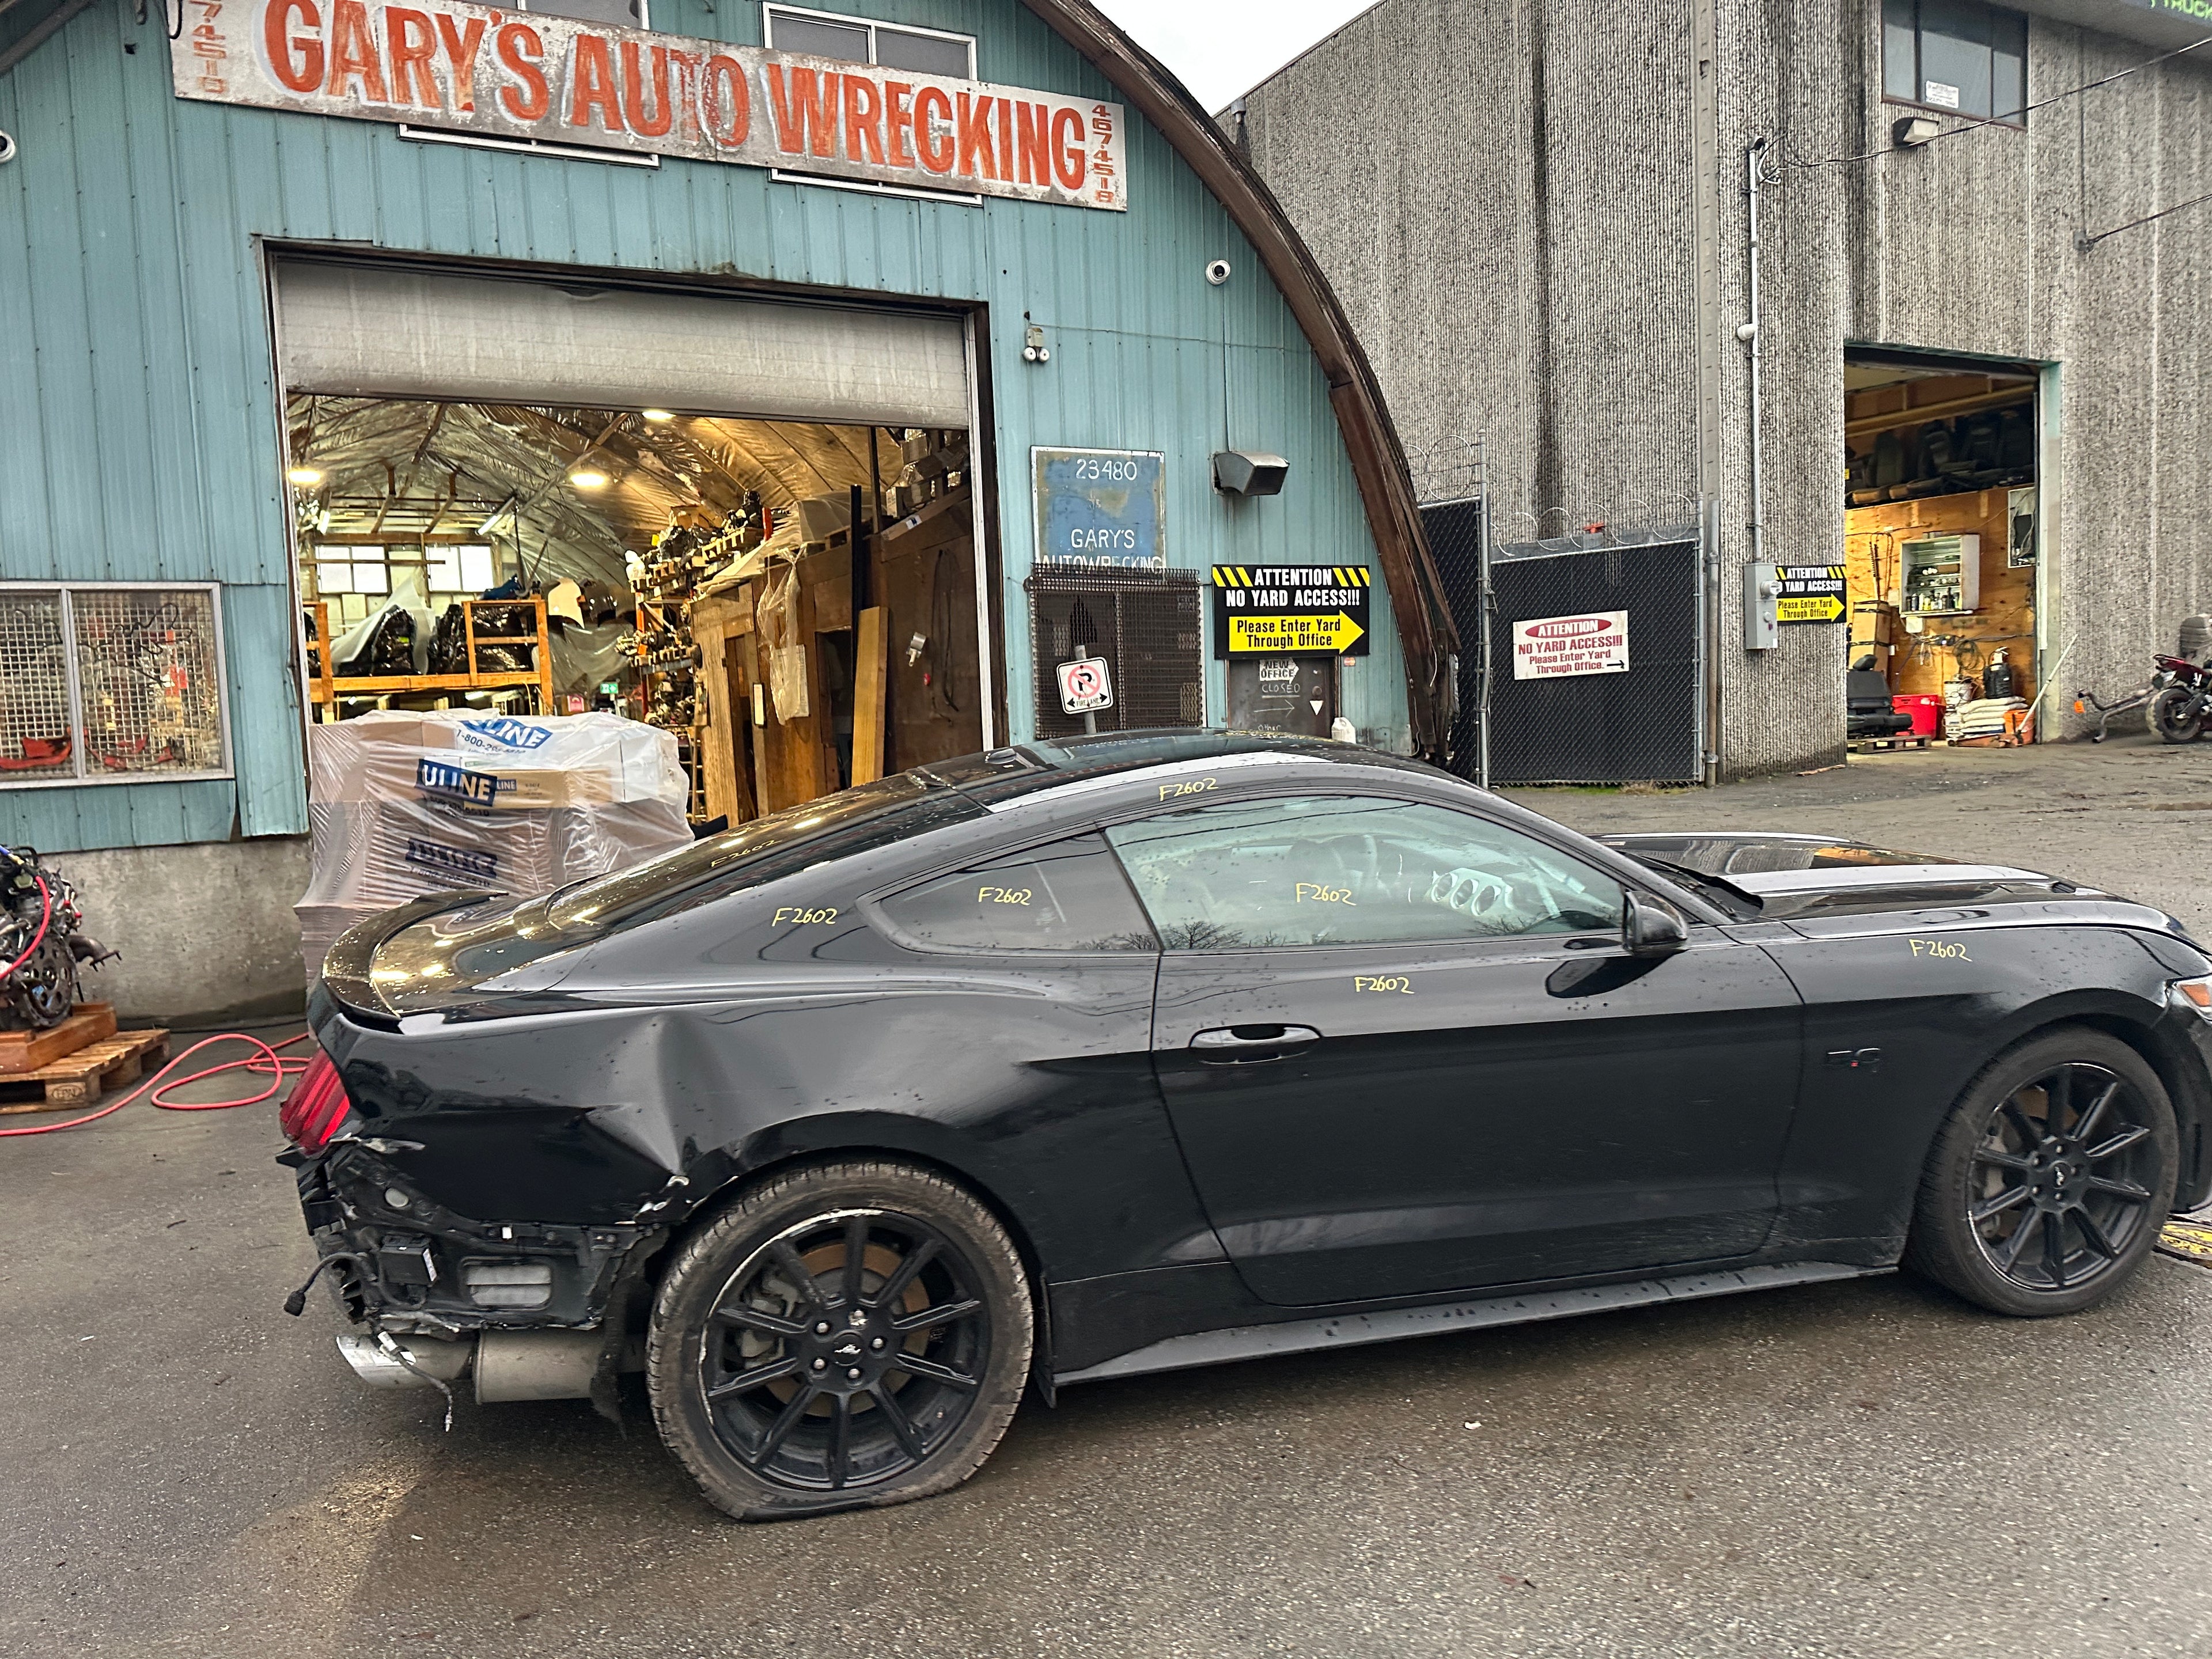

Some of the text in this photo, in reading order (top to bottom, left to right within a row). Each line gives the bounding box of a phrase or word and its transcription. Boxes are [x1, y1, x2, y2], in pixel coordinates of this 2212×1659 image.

[265, 0, 1085, 191] GARY'S AUTO WRECKING
[1076, 459, 1138, 480] 23480
[1071, 529, 1135, 548] GARY'S
[1255, 569, 1332, 586] ATTENTION
[1786, 567, 1828, 579] ATTENTION
[1785, 581, 1805, 592] YARD
[1807, 580, 1843, 592] ACCESS!!!
[1226, 589, 1360, 607] NO YARD ACCESS!!!
[1778, 599, 1832, 609] Please Enter Yard
[1783, 609, 1828, 619] Through Office
[1237, 618, 1340, 632] Please Enter Yard
[1537, 620, 1599, 637] ATTENTION
[1247, 633, 1332, 649] Through Office
[1518, 635, 1623, 655] NO YARD ACCESS!!!
[1264, 660, 1289, 668] NEW
[1529, 649, 1611, 665] Please Enter Yard
[1261, 669, 1295, 678] OFFICE
[1536, 663, 1572, 674] Through
[1262, 683, 1301, 693] CLOSED
[1087, 698, 1100, 706] ANE
[497, 781, 515, 790] LINE
[1159, 778, 1219, 801] F2602
[711, 840, 782, 867] F2602
[978, 887, 1032, 906] F2602
[1296, 883, 1357, 906] F2602
[772, 907, 838, 927] F2602
[1908, 938, 1973, 963] F2602
[1354, 976, 1415, 994] F2602
